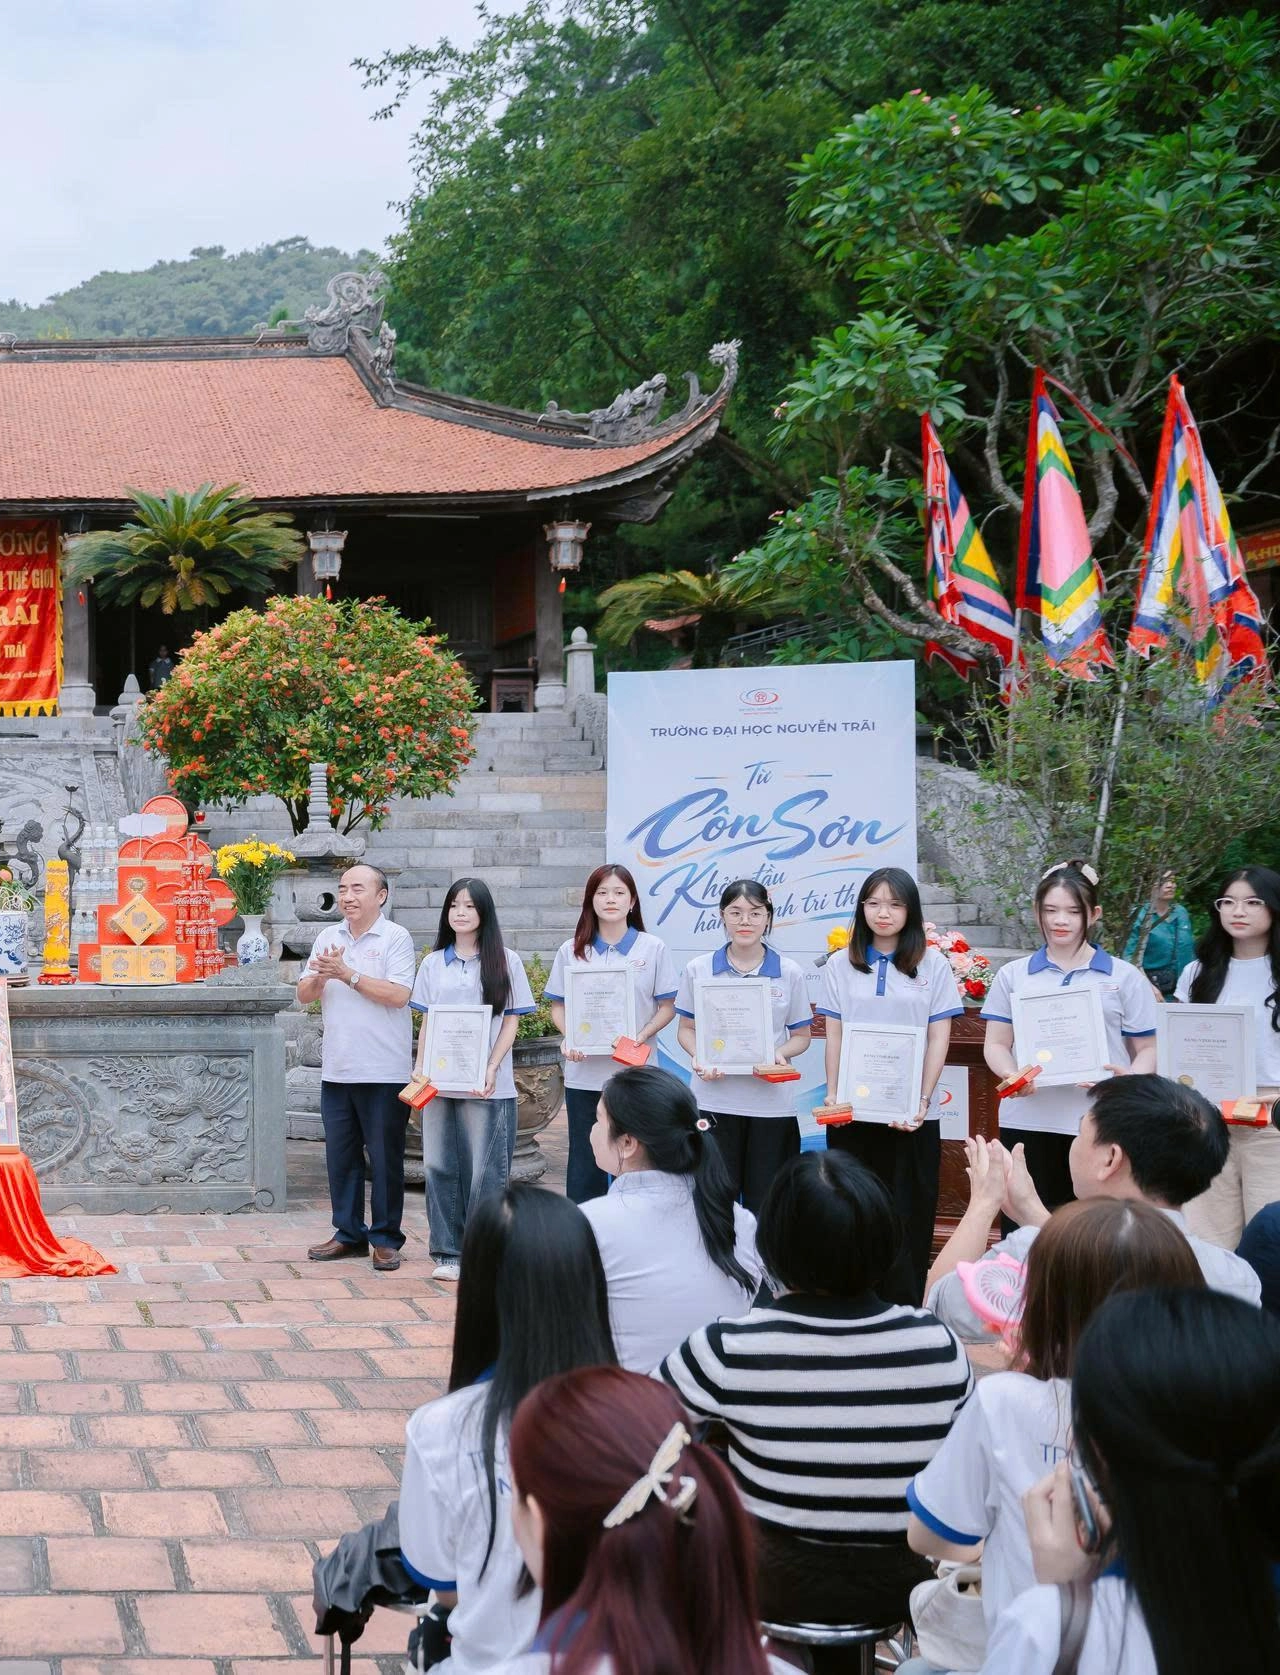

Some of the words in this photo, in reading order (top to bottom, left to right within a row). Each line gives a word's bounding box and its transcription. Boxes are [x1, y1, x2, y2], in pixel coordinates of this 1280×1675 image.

[4, 641, 26, 659] TRÃI
[650, 724, 708, 737] TRƯỜNG
[712, 725, 737, 738] ĐẠI
[742, 724, 772, 737] HỌC
[777, 719, 837, 735] NGUYỄN
[841, 719, 875, 732] TRÃI
[744, 760, 785, 790] Từ
[625, 788, 765, 859] Côn
[766, 789, 908, 860] Sơn
[801, 890, 828, 913] tri
